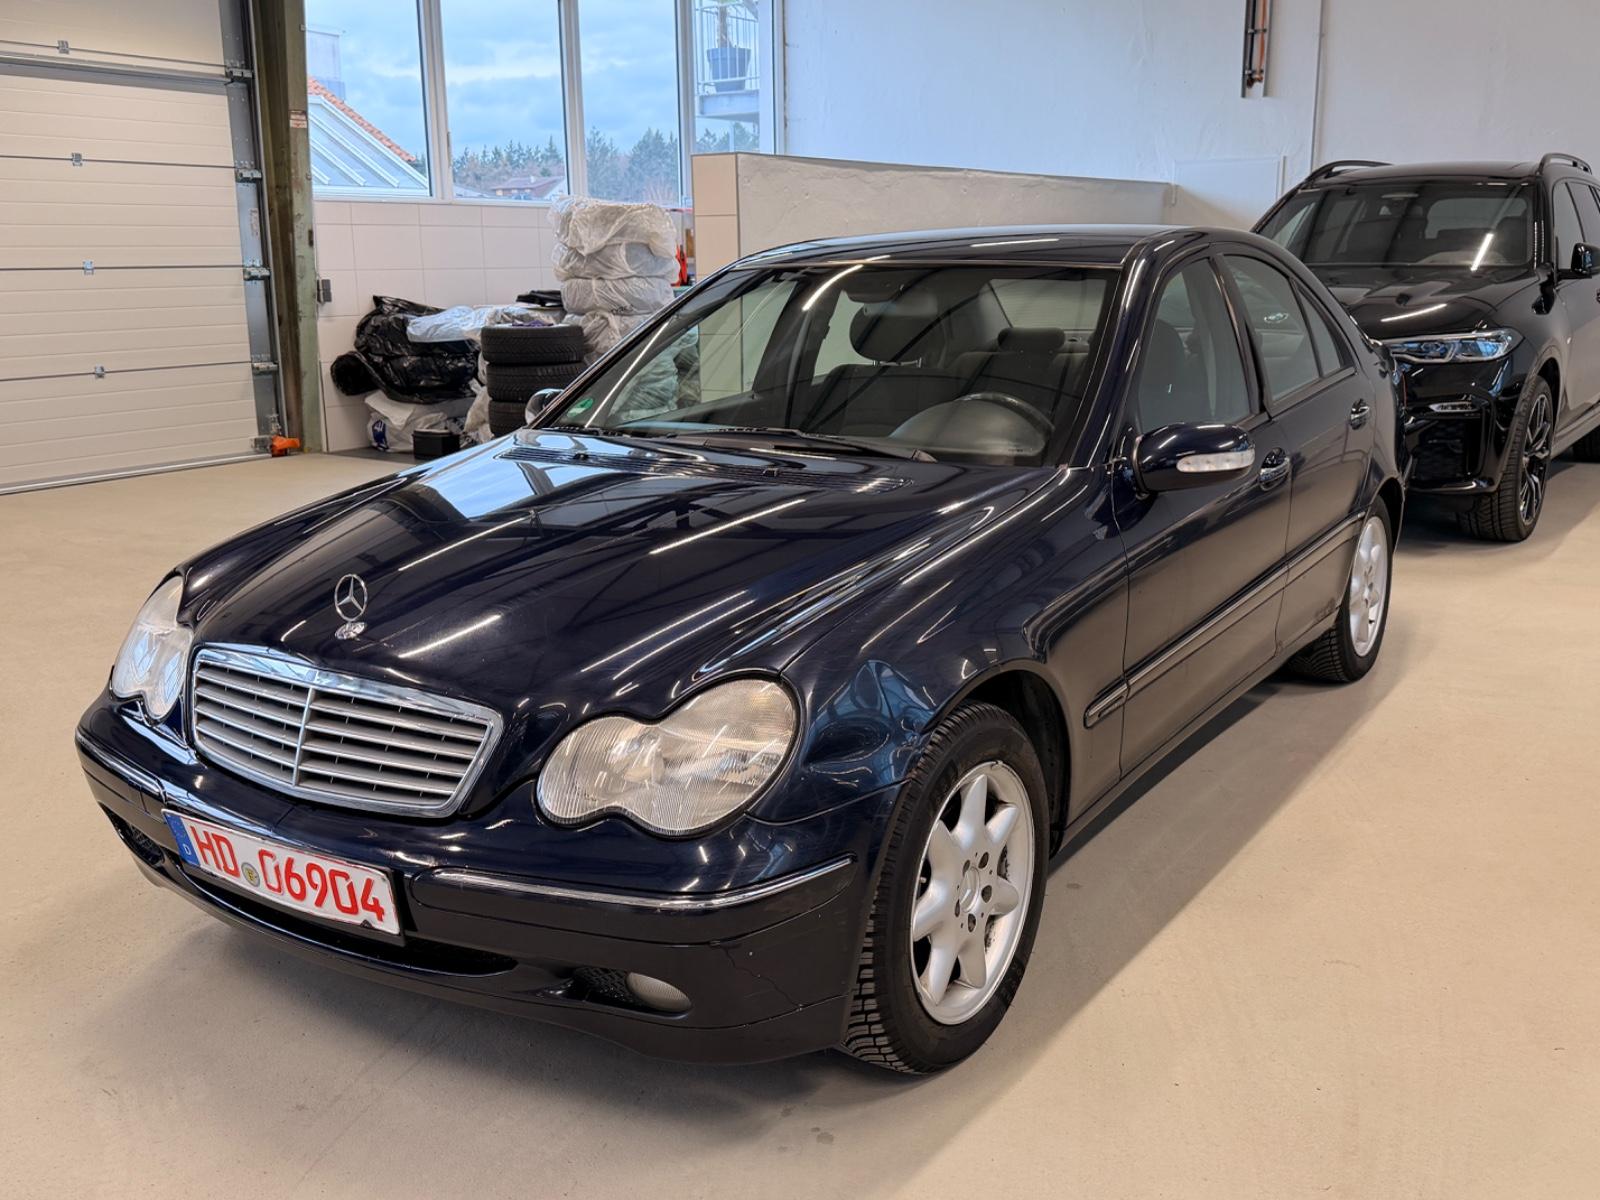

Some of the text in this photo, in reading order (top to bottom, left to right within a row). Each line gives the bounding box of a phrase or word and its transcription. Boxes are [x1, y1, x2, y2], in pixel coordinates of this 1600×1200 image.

[182, 843, 192, 856] D
[191, 827, 386, 923] HD 06904
